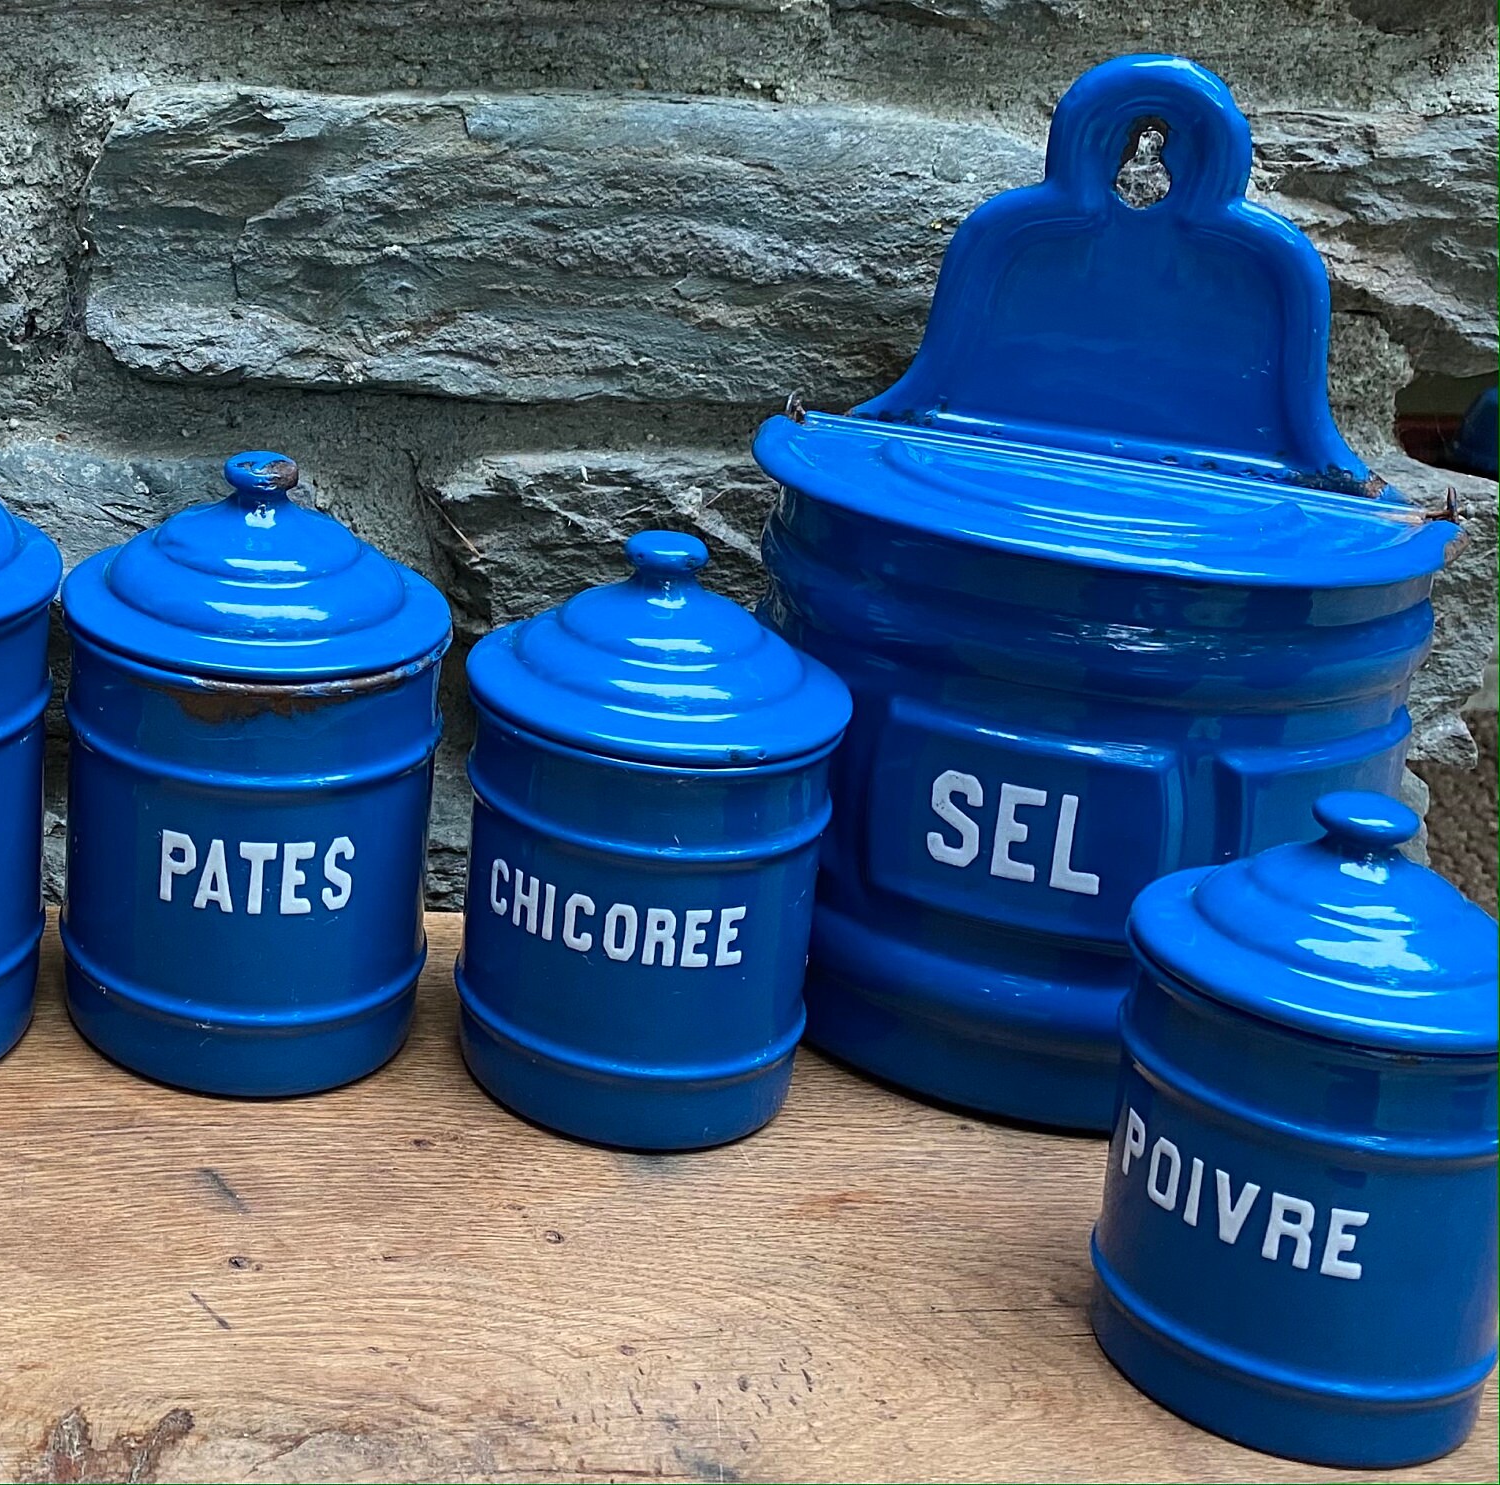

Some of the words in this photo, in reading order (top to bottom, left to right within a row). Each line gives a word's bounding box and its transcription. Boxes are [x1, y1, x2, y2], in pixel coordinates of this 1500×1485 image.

[158, 829, 357, 916] PATES
[924, 767, 1102, 896] SEL
[488, 857, 748, 968] CHICOREE
[1120, 1108, 1371, 1281] POIVRE
